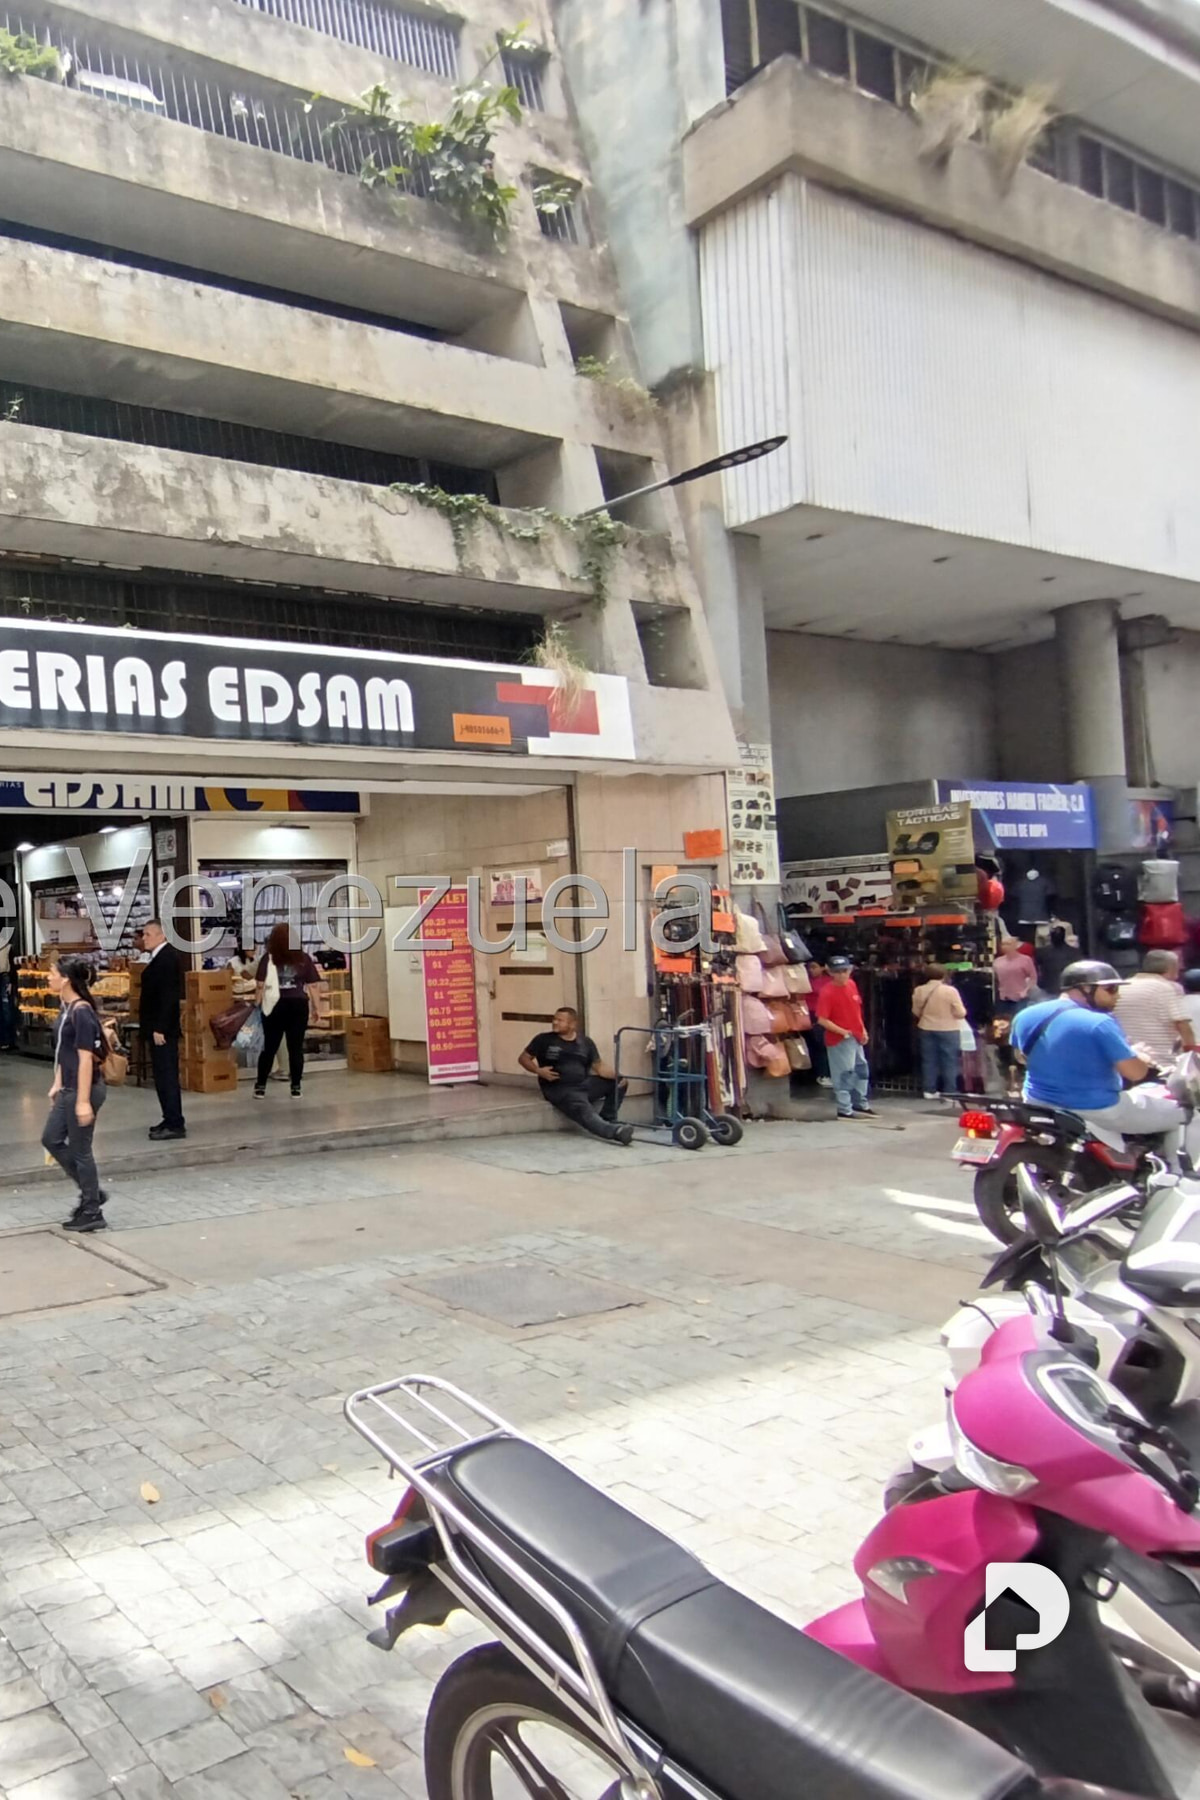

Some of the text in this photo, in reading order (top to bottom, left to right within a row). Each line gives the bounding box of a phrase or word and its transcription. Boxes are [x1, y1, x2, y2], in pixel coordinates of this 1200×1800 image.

[208, 666, 415, 732] EDSAM
[23, 781, 196, 810] EDSAM
[422, 893, 467, 905] OTLET
